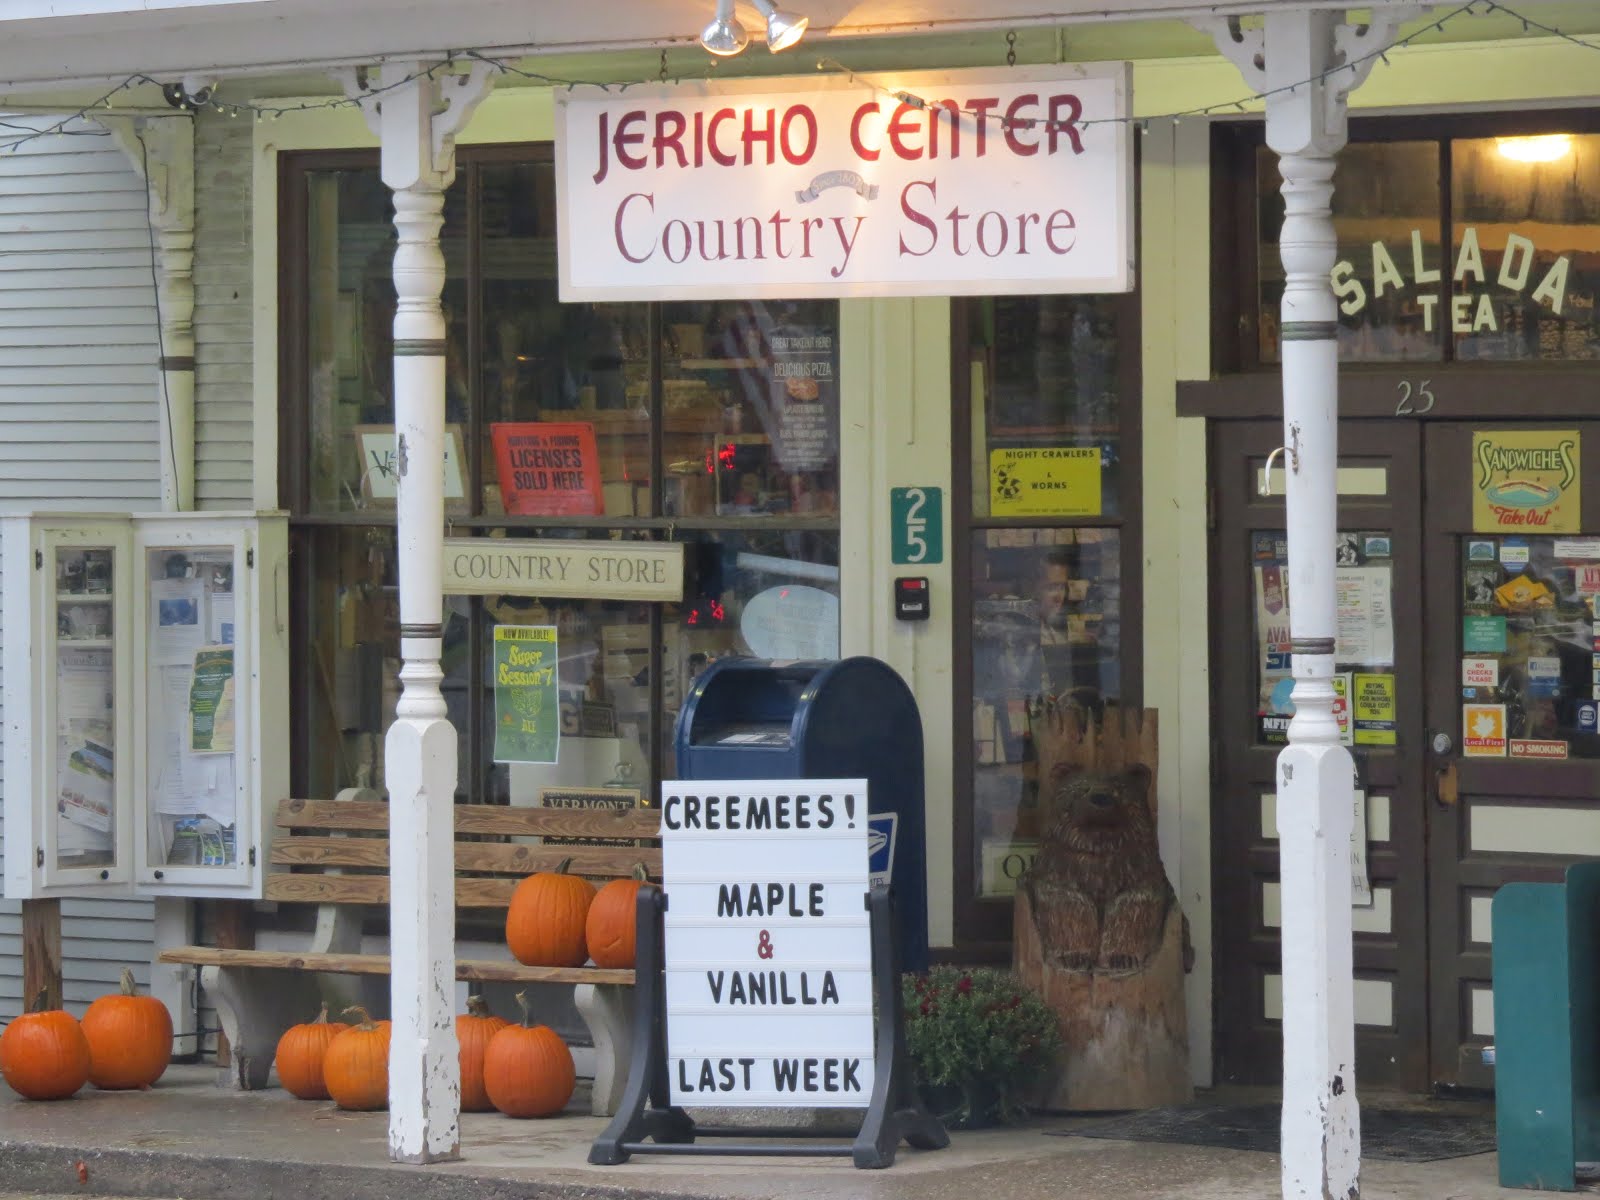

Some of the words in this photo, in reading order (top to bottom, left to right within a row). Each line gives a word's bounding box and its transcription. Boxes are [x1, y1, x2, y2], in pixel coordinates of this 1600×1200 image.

[592, 102, 818, 185] JERICHO
[850, 93, 1085, 162] CENTER
[614, 192, 868, 278] Country
[899, 179, 1077, 257] Store
[1330, 227, 1569, 316] SALADA
[1417, 294, 1497, 332] TEA
[774, 362, 810, 377] DELICIOUS
[811, 362, 832, 376] PIZZA
[1395, 379, 1435, 417] 25
[509, 449, 582, 468] LICENSES
[1005, 450, 1038, 459] NIGHT
[1042, 449, 1095, 459] CRAWLERS
[1478, 439, 1575, 491] SANDWICHES
[513, 471, 548, 490] SOLD
[551, 471, 585, 490] HERE
[905, 488, 927, 563] 25
[453, 554, 572, 581] COUNTRY
[588, 557, 666, 584] STORE
[503, 628, 517, 639] NOW
[509, 645, 542, 667] Super
[498, 662, 541, 687] Session
[1465, 738, 1485, 746] Local
[1486, 739, 1505, 747] First
[1512, 743, 1524, 753] NO
[1526, 744, 1565, 755] SMOKING
[549, 798, 629, 810] VERMONT
[664, 794, 856, 830] CREEMEES!
[717, 882, 825, 918] MAPLE
[757, 928, 774, 960] &
[707, 970, 839, 1006] VANILLA
[678, 1058, 755, 1093] LAST
[773, 1058, 861, 1093] WEEK
